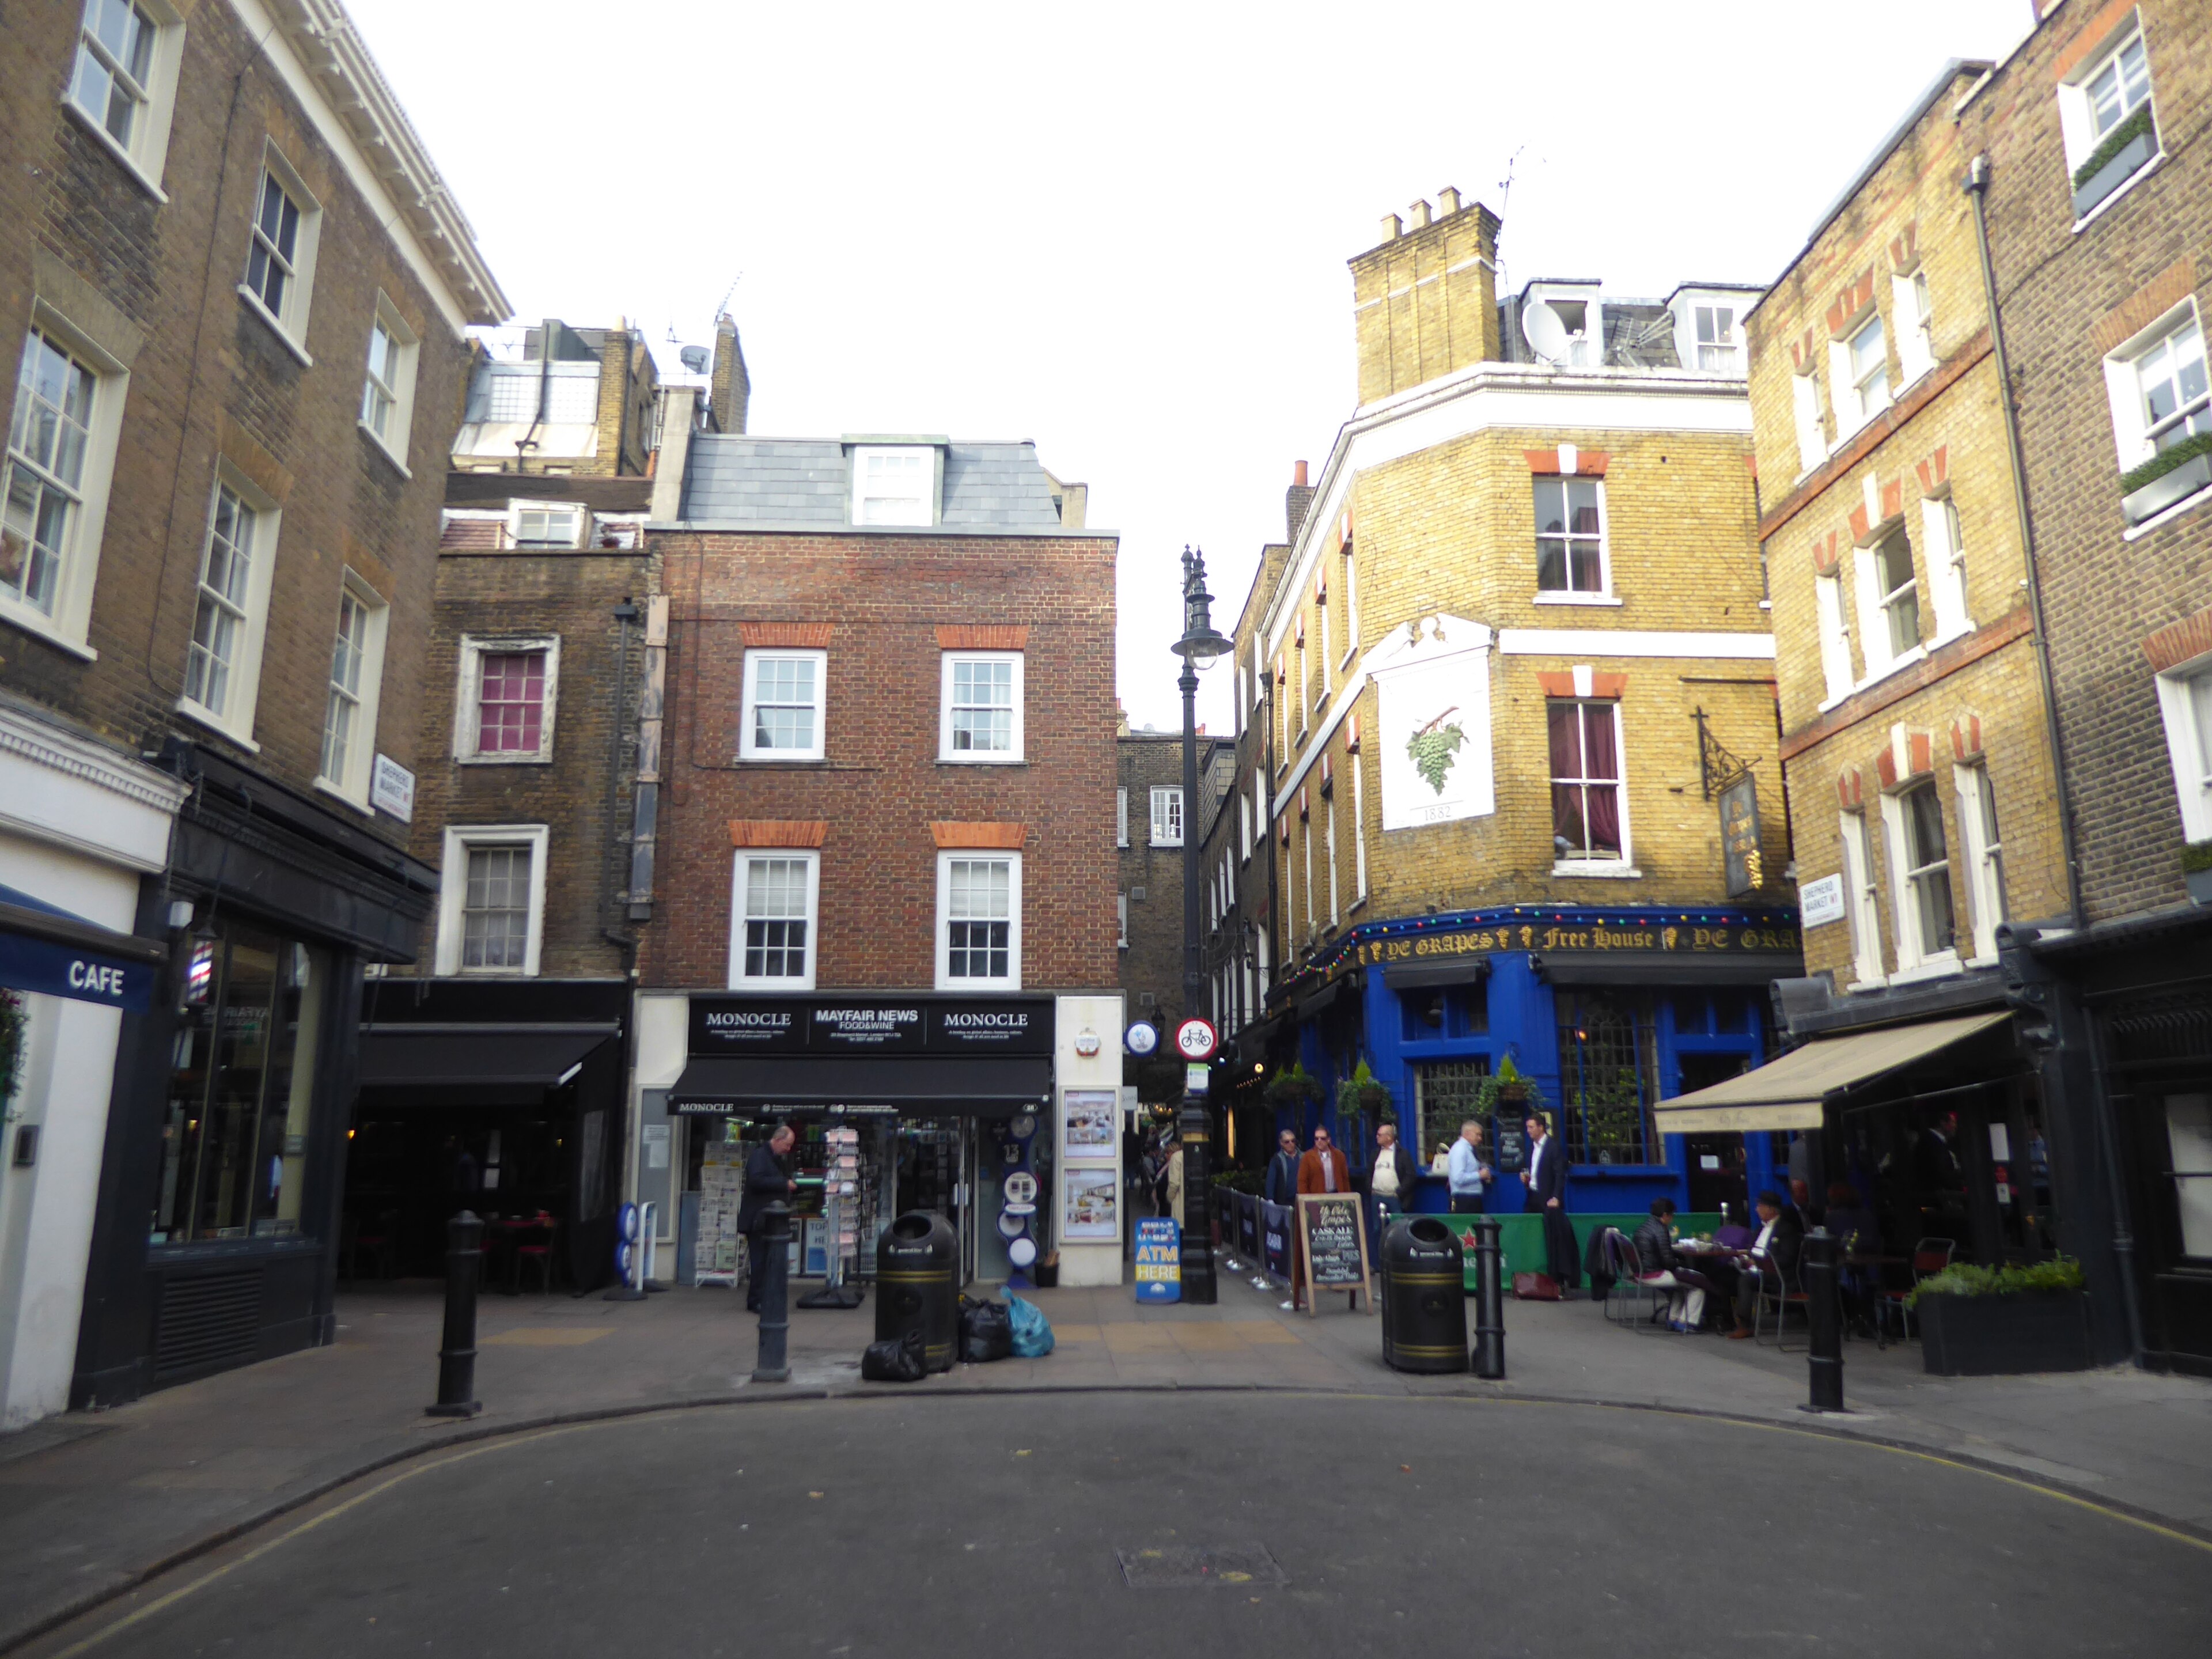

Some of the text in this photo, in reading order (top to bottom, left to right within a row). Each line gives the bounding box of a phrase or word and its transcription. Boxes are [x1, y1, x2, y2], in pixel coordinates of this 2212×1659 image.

[1425, 806, 1451, 821] 1882
[1415, 932, 1494, 956] GRAPES
[1543, 927, 1654, 950] Free House
[69, 960, 125, 995] CAFE
[706, 1013, 791, 1026] MONOCLE
[816, 1010, 919, 1021] MAYFAIR NEWS
[944, 1014, 1028, 1027] MONOCLE
[839, 1021, 895, 1029] FOOD&WINE
[679, 1103, 734, 1112] MONOCLE
[1137, 1245, 1178, 1262] ATM
[1139, 1264, 1178, 1279] HERE
